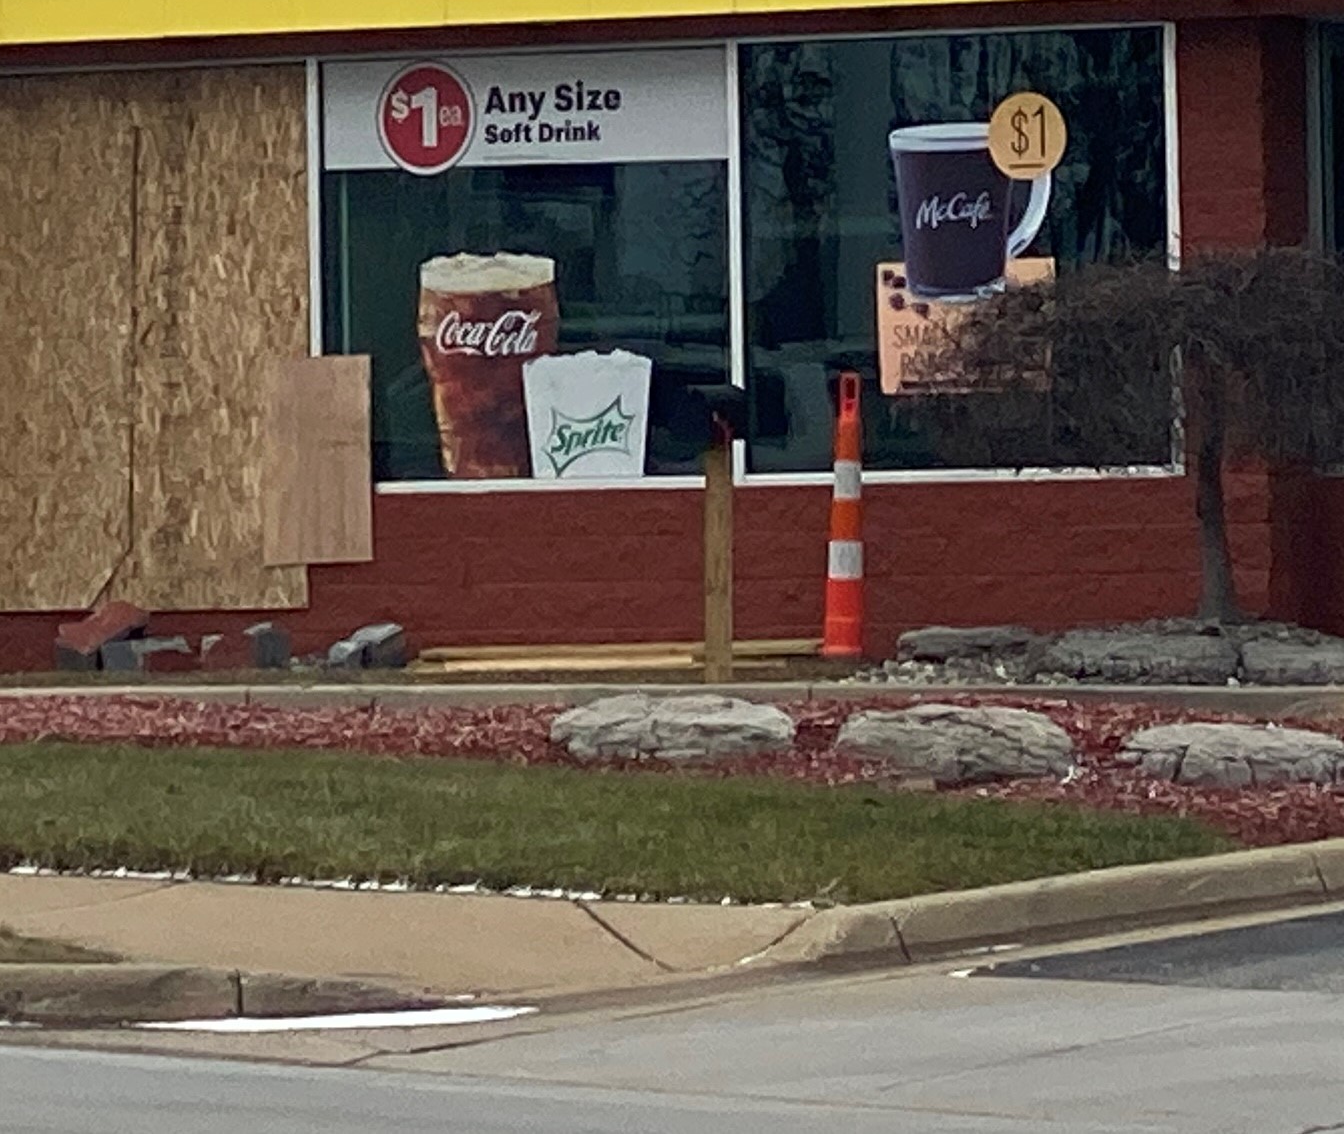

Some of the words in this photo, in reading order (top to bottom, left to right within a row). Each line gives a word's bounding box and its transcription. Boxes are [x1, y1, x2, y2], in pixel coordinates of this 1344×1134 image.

[484, 86, 545, 120] Any
[554, 79, 621, 113] Size
[484, 123, 532, 145] Soft
[538, 120, 601, 143] Drink
[1010, 104, 1046, 157] $1
[550, 418, 624, 456] Sprite
